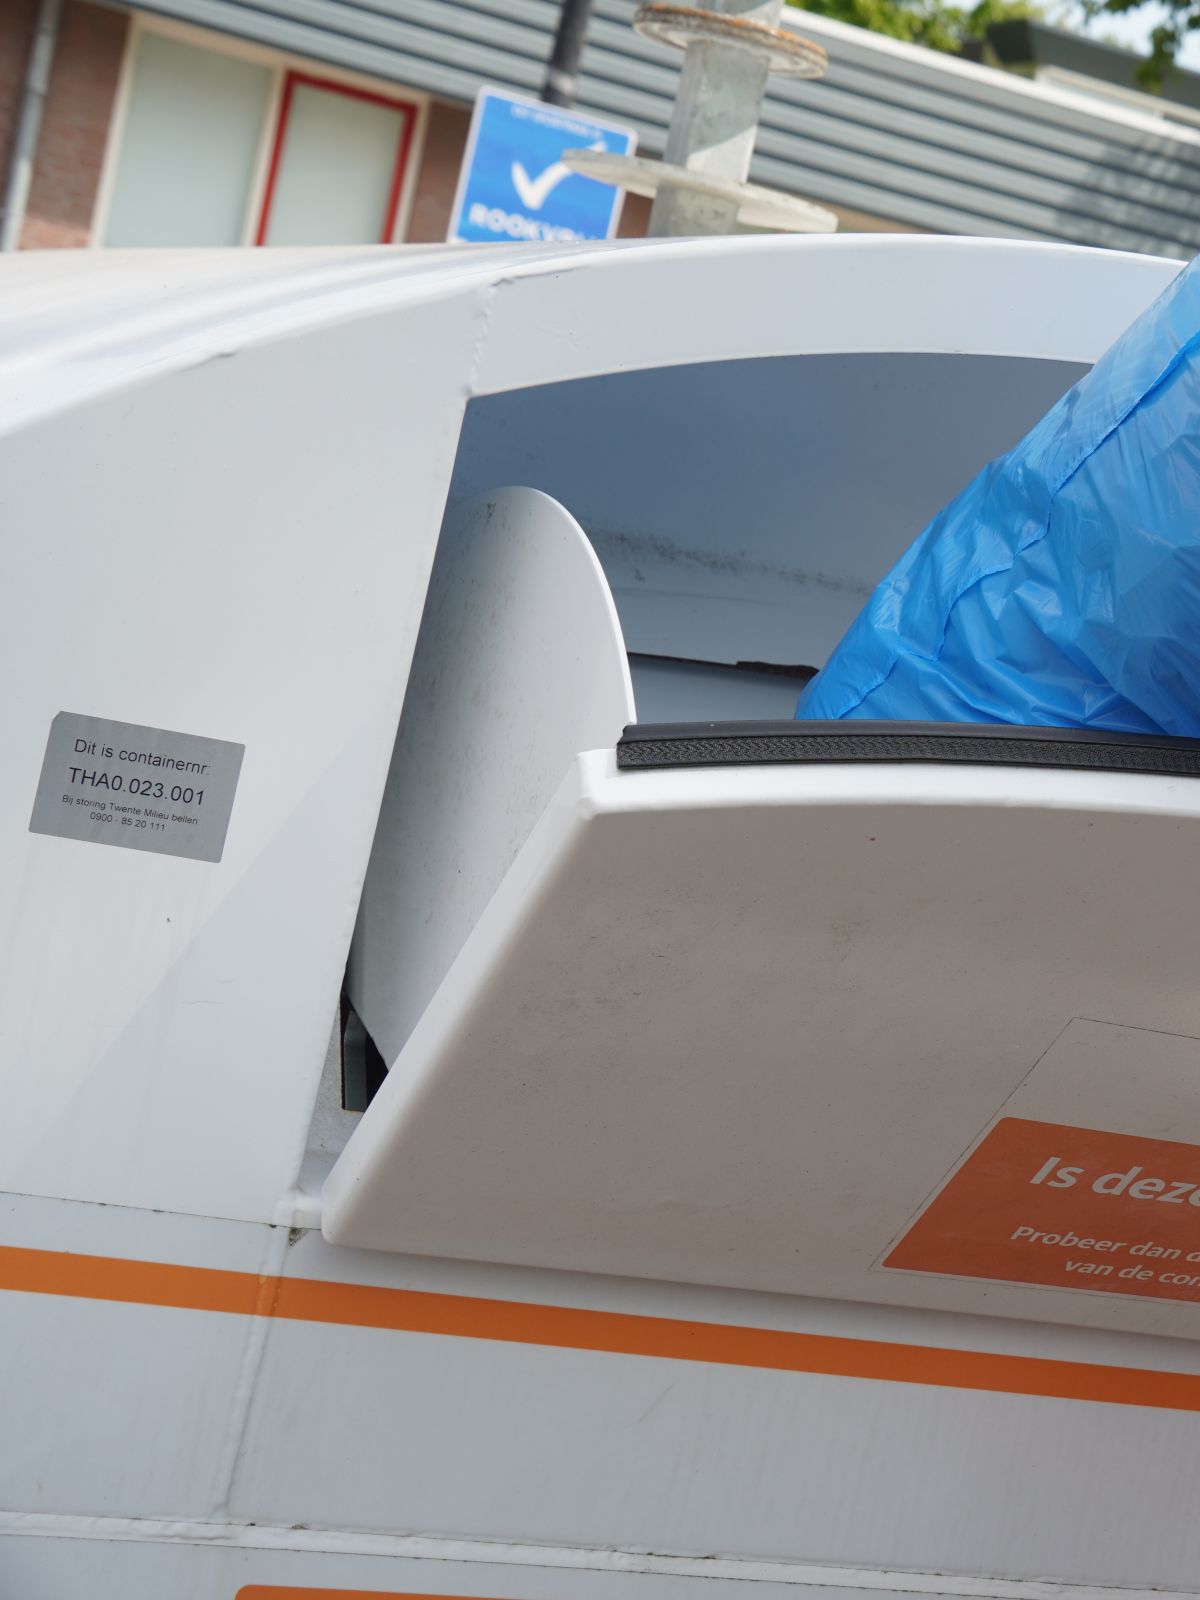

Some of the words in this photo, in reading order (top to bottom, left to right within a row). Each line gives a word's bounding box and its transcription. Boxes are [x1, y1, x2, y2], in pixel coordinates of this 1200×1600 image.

[74, 738, 96, 756] Dit
[101, 743, 114, 758] is
[68, 766, 205, 806] THA0.023.001
[62, 794, 74, 807] Bij
[76, 797, 106, 811] storing
[109, 802, 141, 816] Twente
[144, 808, 169, 821] Milieu
[90, 811, 113, 823] 0900
[121, 817, 133, 827] 85
[134, 819, 147, 829] 20
[150, 822, 166, 832] 111
[1029, 1156, 1085, 1188] Is
[1010, 1225, 1127, 1254] Probeer
[1129, 1240, 1182, 1262] dan
[1064, 1259, 1114, 1277] van
[1118, 1263, 1155, 1281] de
